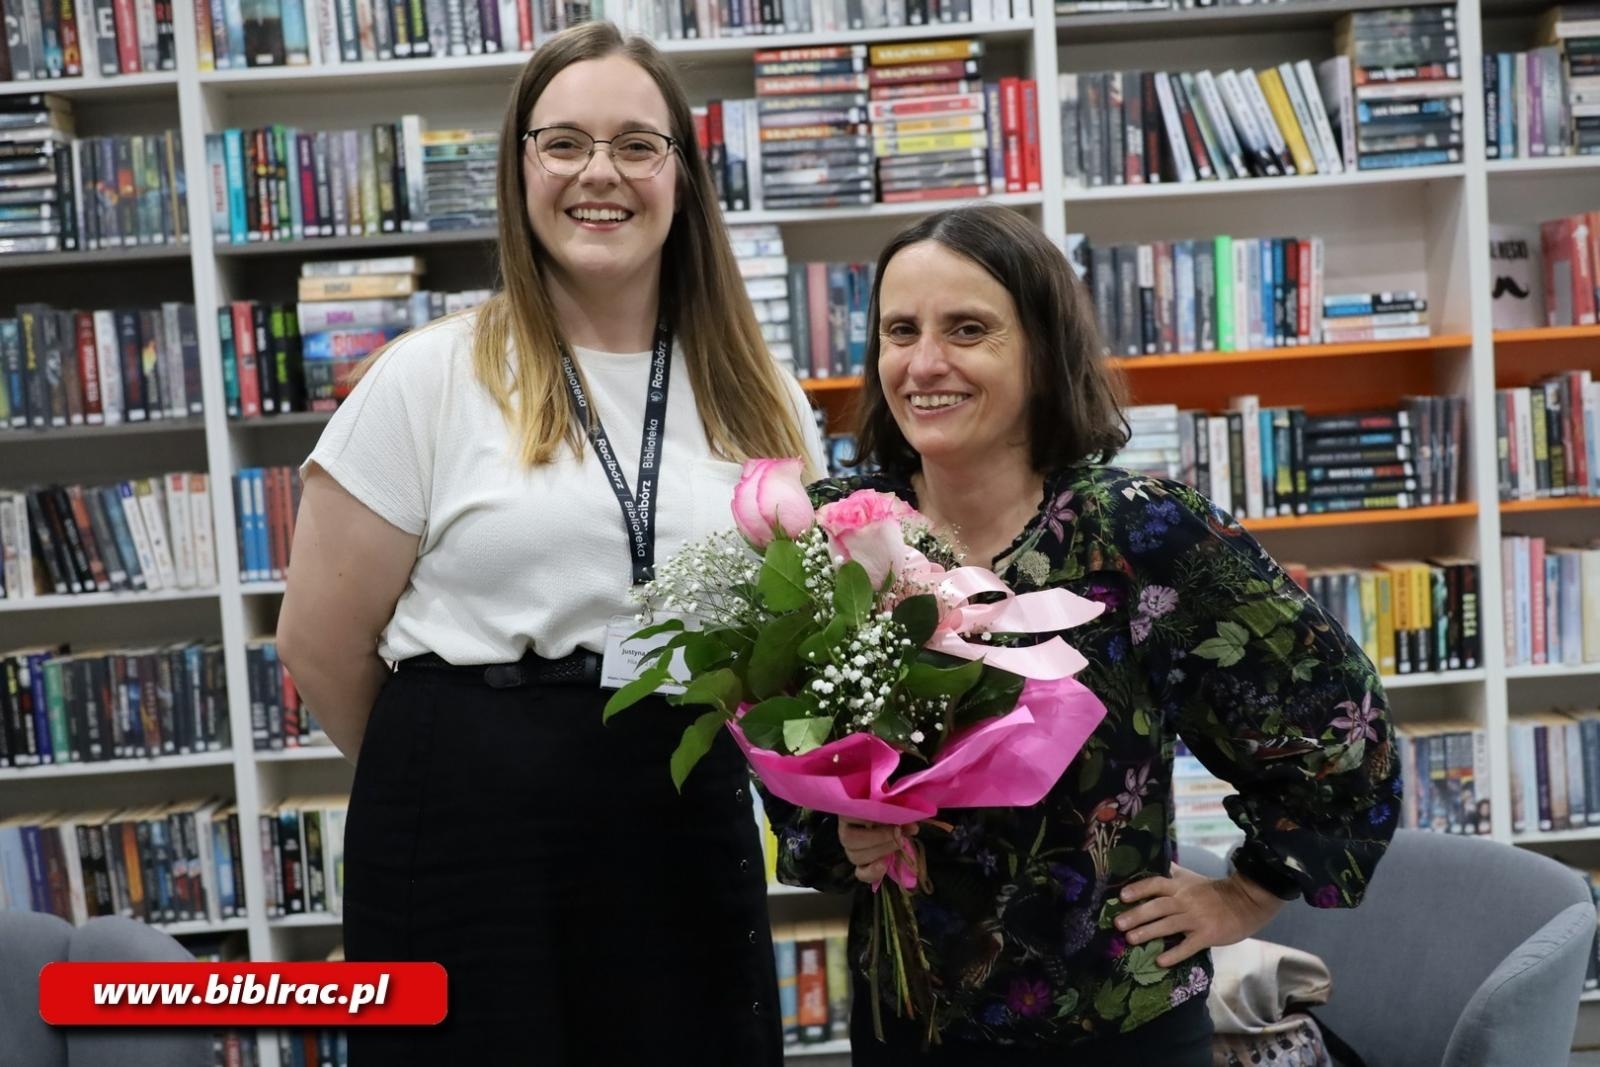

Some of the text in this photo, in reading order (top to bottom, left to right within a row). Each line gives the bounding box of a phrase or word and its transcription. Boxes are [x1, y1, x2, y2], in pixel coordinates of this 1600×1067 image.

[562, 356, 647, 557] Biblioteka Racibórz Biblioteka
[637, 340, 667, 531] cibórz Biblioteka Racibórz
